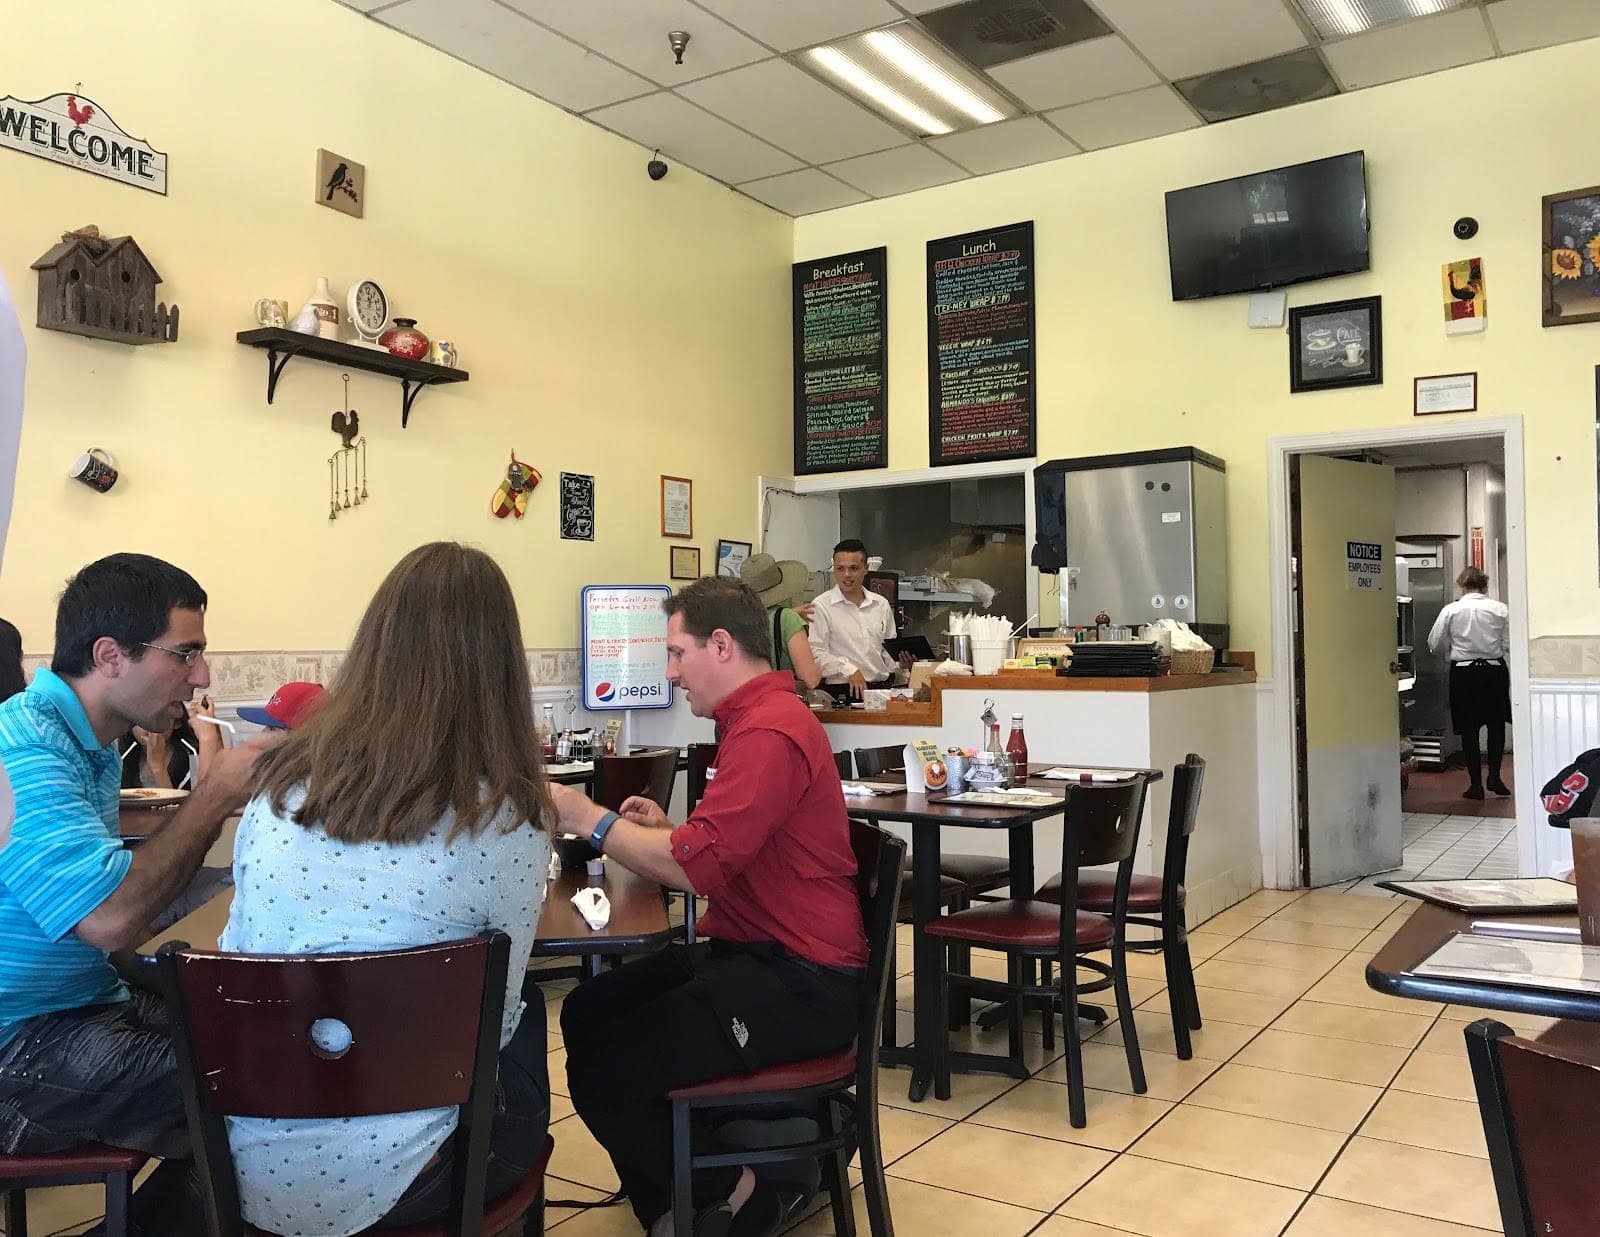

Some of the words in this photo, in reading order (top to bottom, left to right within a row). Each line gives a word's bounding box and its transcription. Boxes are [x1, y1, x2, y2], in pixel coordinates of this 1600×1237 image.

[0, 104, 155, 181] WELCOME
[962, 239, 997, 257] Lunch
[813, 260, 865, 281] Breakfast
[1350, 543, 1379, 559] NOTICE
[1348, 561, 1381, 574] EMPLOYEES
[1358, 577, 1372, 588] ONLY
[619, 683, 662, 699] pepsi
